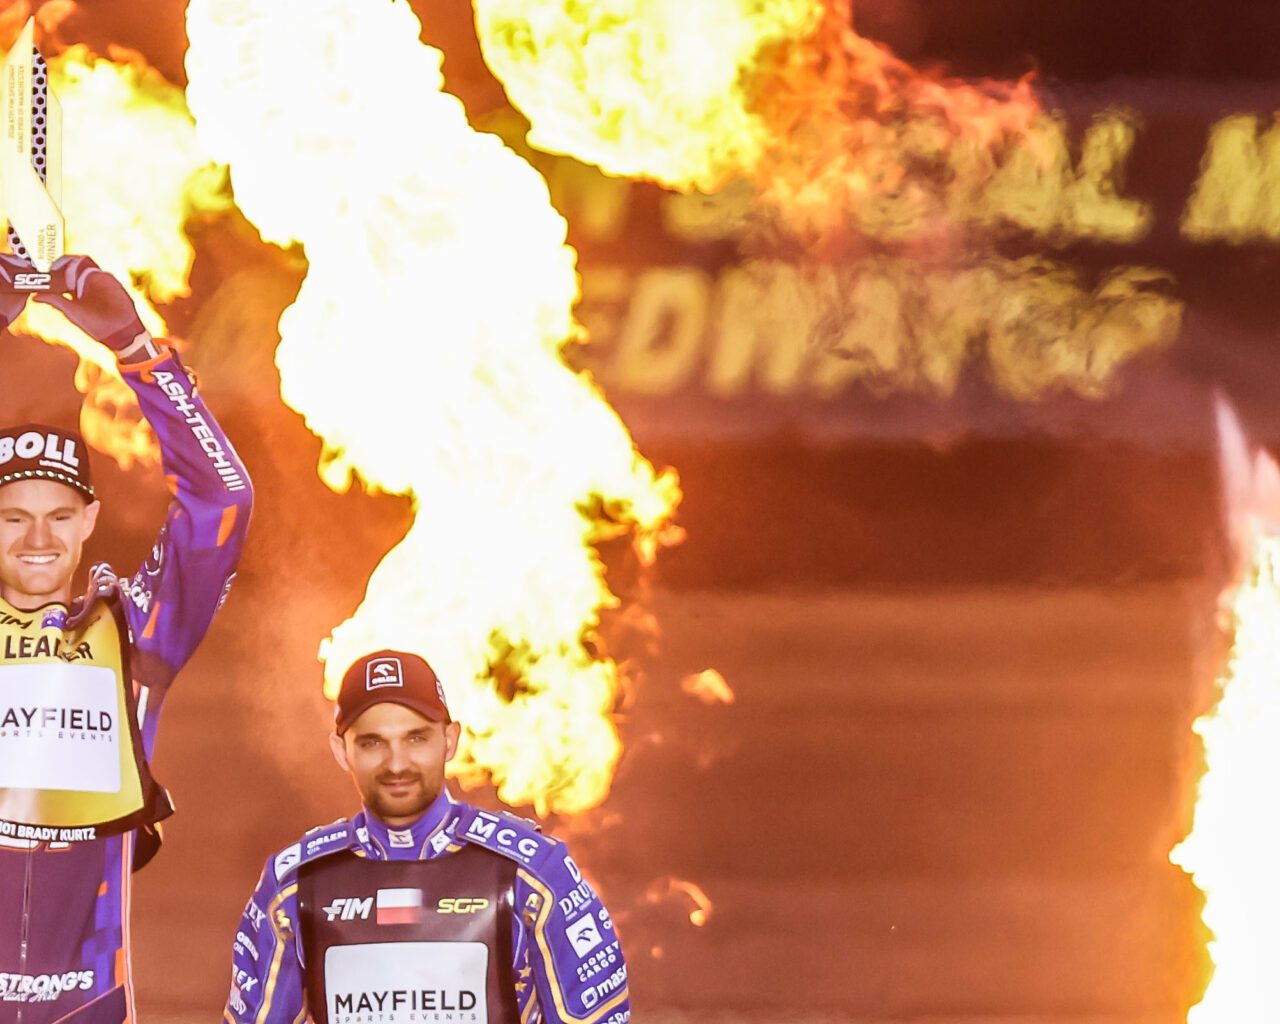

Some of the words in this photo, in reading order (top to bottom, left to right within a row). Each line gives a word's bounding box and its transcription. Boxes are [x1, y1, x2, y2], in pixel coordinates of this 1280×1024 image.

[13, 273, 52, 286] SGP
[371, 675, 397, 685] ORLEN
[57, 731, 113, 743] EVENTS
[17, 824, 58, 841] BRADY
[59, 827, 96, 842] KURTZ
[306, 830, 348, 850] ORLEN
[467, 814, 540, 858] MCG
[322, 896, 374, 922] FIM
[436, 897, 490, 914] SGP
[579, 953, 617, 983] CARGO
[334, 990, 477, 1015] MAYFIELD
[335, 1013, 395, 1024] SPORTS
[410, 1012, 477, 1022] EVENTS
